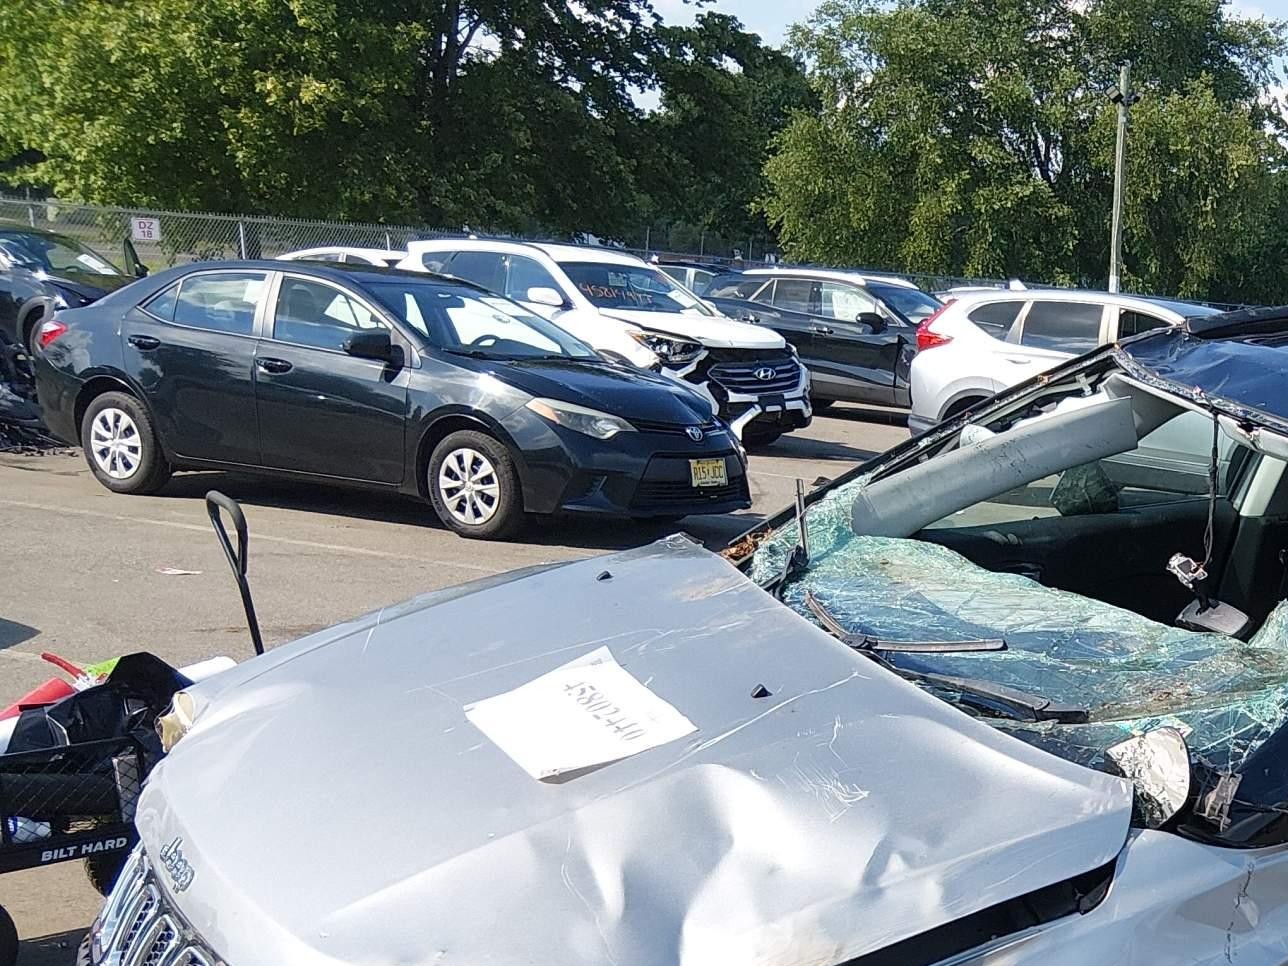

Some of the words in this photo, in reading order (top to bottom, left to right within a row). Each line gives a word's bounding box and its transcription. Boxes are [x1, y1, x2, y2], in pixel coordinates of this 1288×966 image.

[138, 221, 154, 230] DZ
[140, 230, 153, 239] 18
[41, 845, 78, 862] BILT
[81, 837, 128, 855] HARD
[159, 836, 195, 894] Jeep
